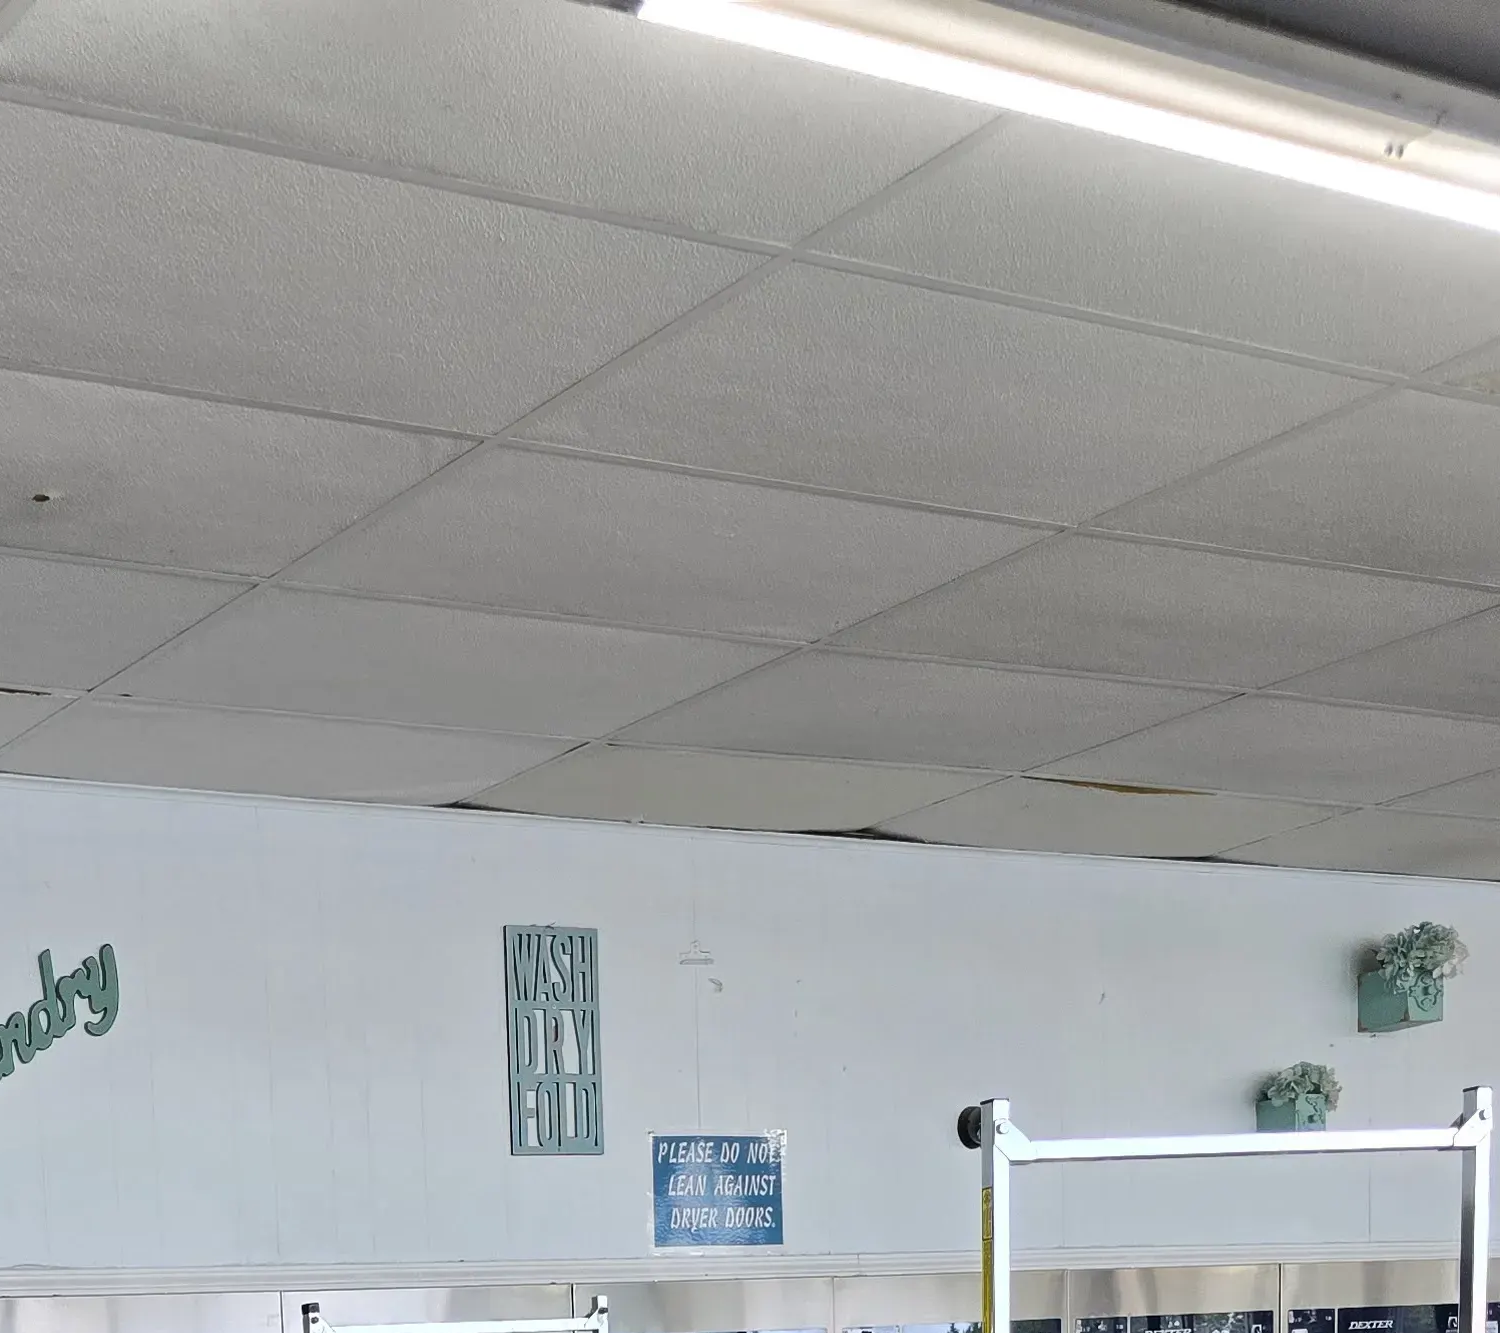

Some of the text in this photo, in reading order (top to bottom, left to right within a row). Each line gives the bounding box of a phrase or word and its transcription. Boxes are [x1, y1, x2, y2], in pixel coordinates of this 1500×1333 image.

[512, 933, 593, 1003] WASH
[516, 1008, 595, 1075] DRY
[517, 1082, 598, 1147] FOLD
[657, 1142, 714, 1164] PLEASE
[720, 1142, 740, 1164] DO
[668, 1174, 776, 1196] LEAN AGAINST
[670, 1207, 776, 1232] DRYER DOORS.
[1348, 1320, 1393, 1330] DEXTER
